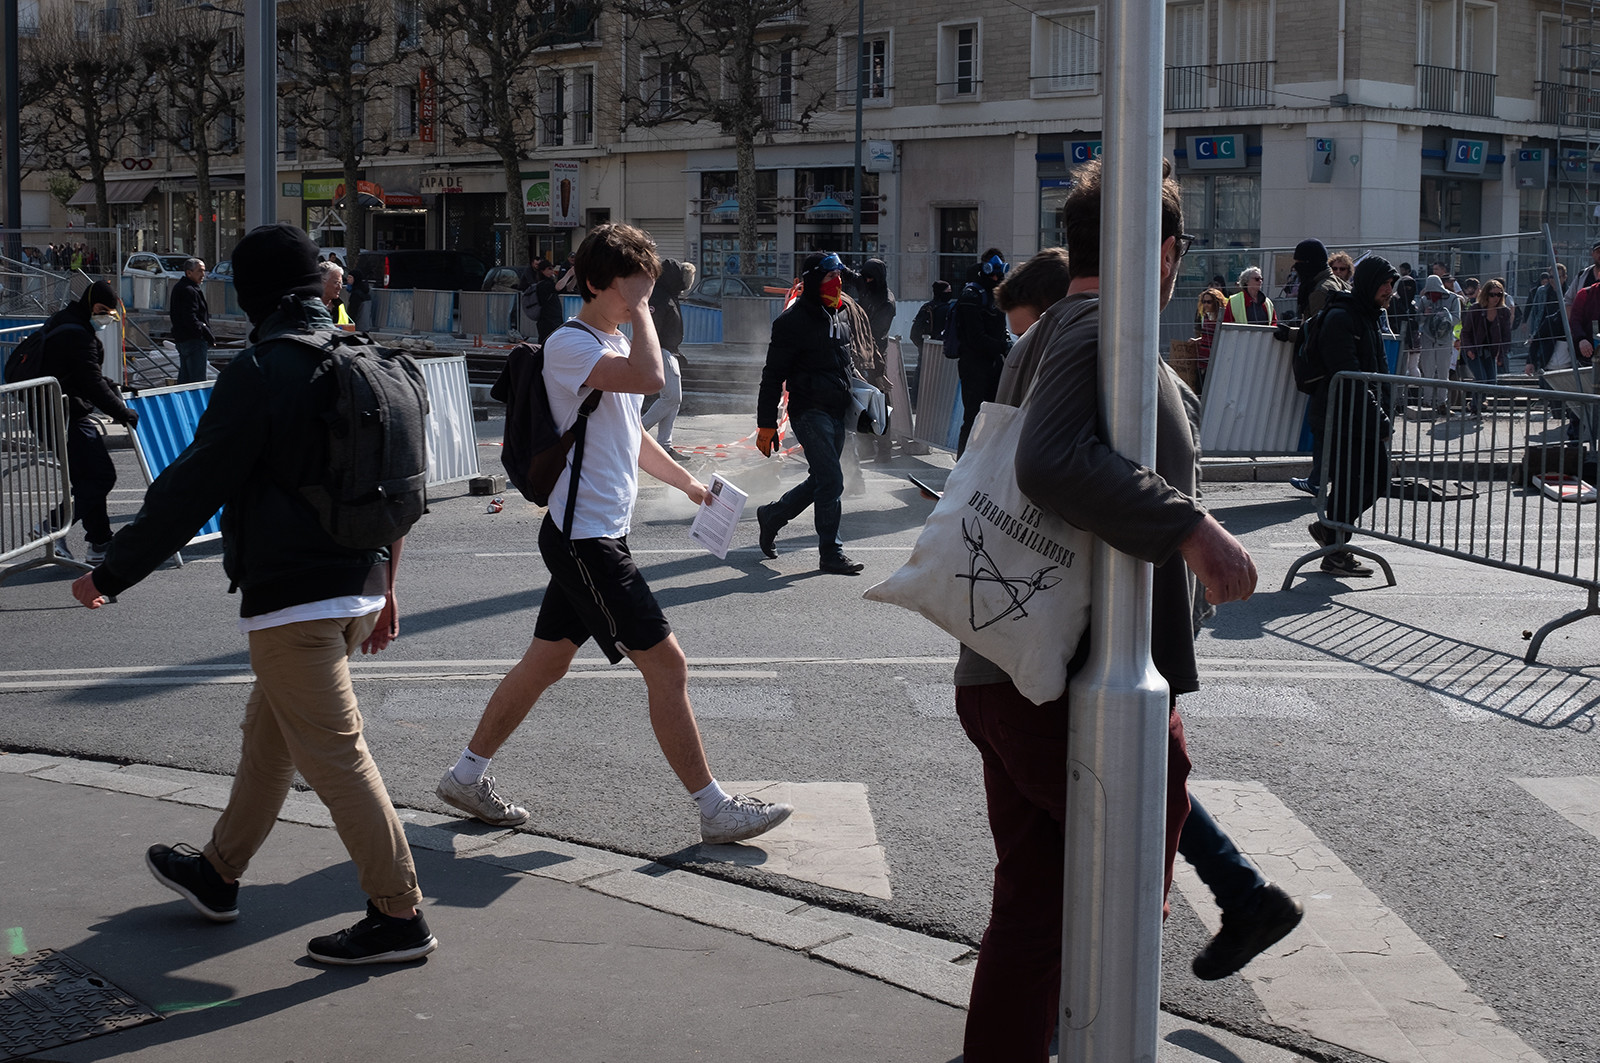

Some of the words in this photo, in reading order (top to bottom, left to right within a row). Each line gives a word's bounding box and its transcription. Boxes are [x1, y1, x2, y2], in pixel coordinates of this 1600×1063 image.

[1199, 141, 1231, 155] CIC
[1317, 141, 1331, 150] CIC
[1458, 145, 1480, 160] CIC
[1521, 152, 1539, 160] CIC
[805, 184, 823, 201] Guy
[824, 184, 854, 201] Hoquet
[1020, 504, 1044, 529] LES
[968, 490, 1076, 569] DÉBROUSSAILLEUSES
